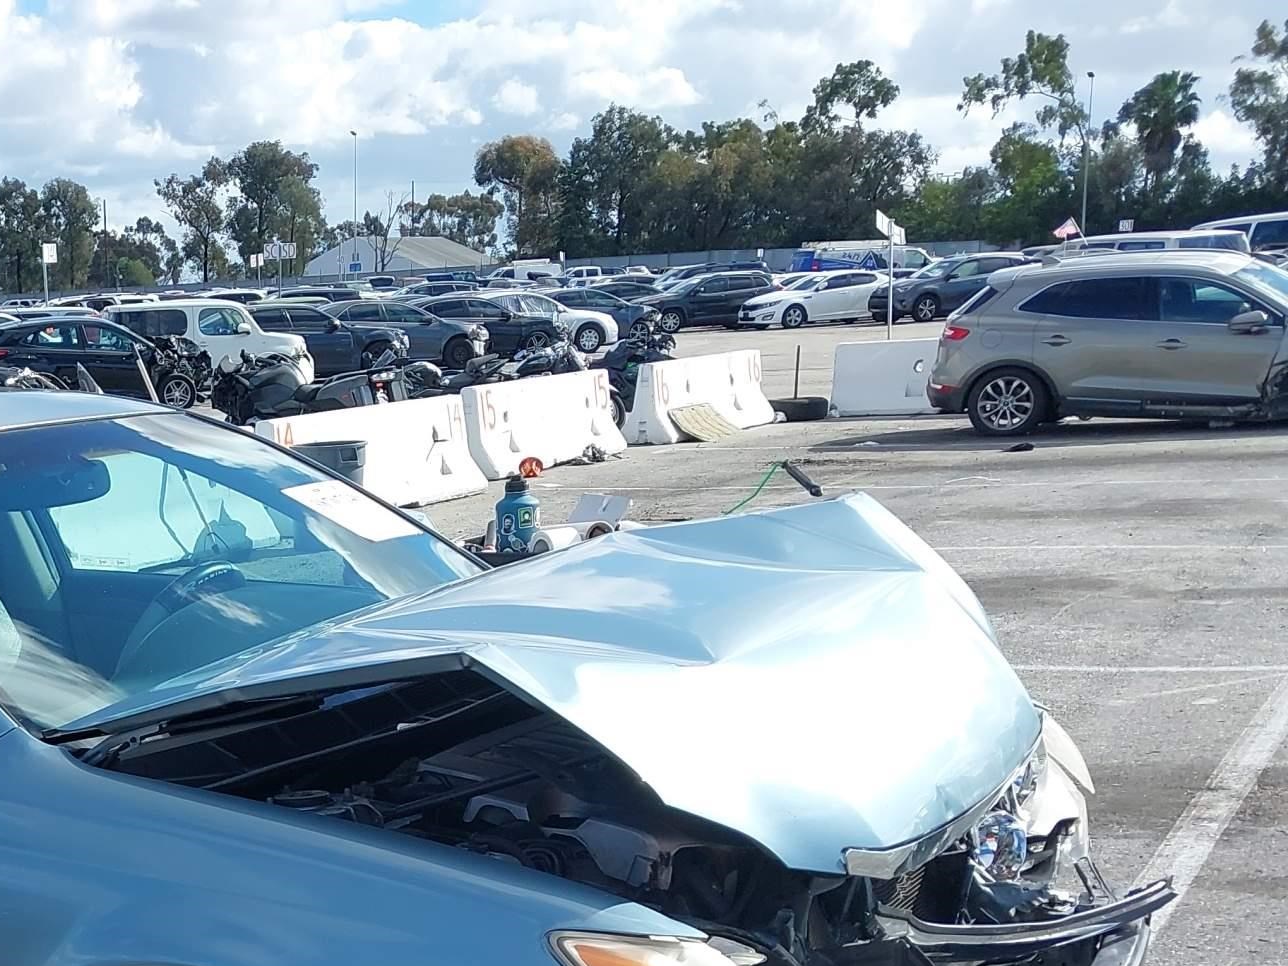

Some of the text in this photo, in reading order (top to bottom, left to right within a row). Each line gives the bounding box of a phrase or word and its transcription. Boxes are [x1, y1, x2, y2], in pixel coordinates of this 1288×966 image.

[264, 243, 296, 258] SC SD
[655, 368, 670, 405] 16
[747, 356, 760, 384] 16
[593, 373, 607, 410] 15
[479, 390, 497, 431] 15
